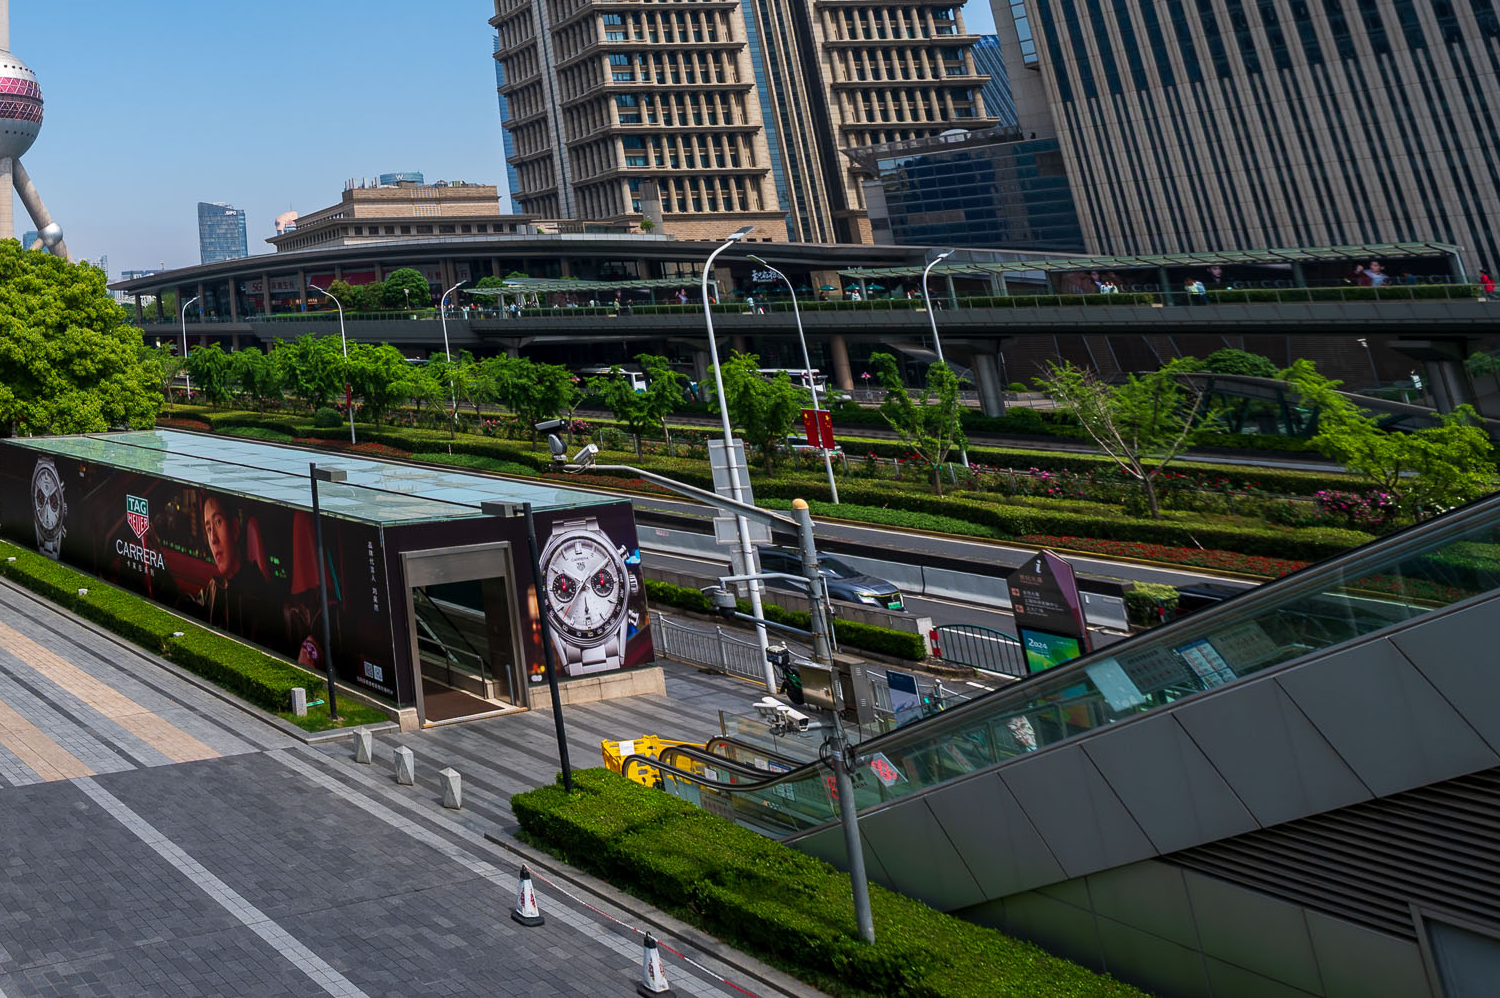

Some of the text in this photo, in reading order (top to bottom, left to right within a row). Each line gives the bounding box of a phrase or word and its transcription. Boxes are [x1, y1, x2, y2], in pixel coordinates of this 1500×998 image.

[128, 497, 147, 515] TAG
[128, 514, 148, 534] HEUER
[115, 539, 165, 570] CARRERA
[1027, 637, 1048, 650] 2024
